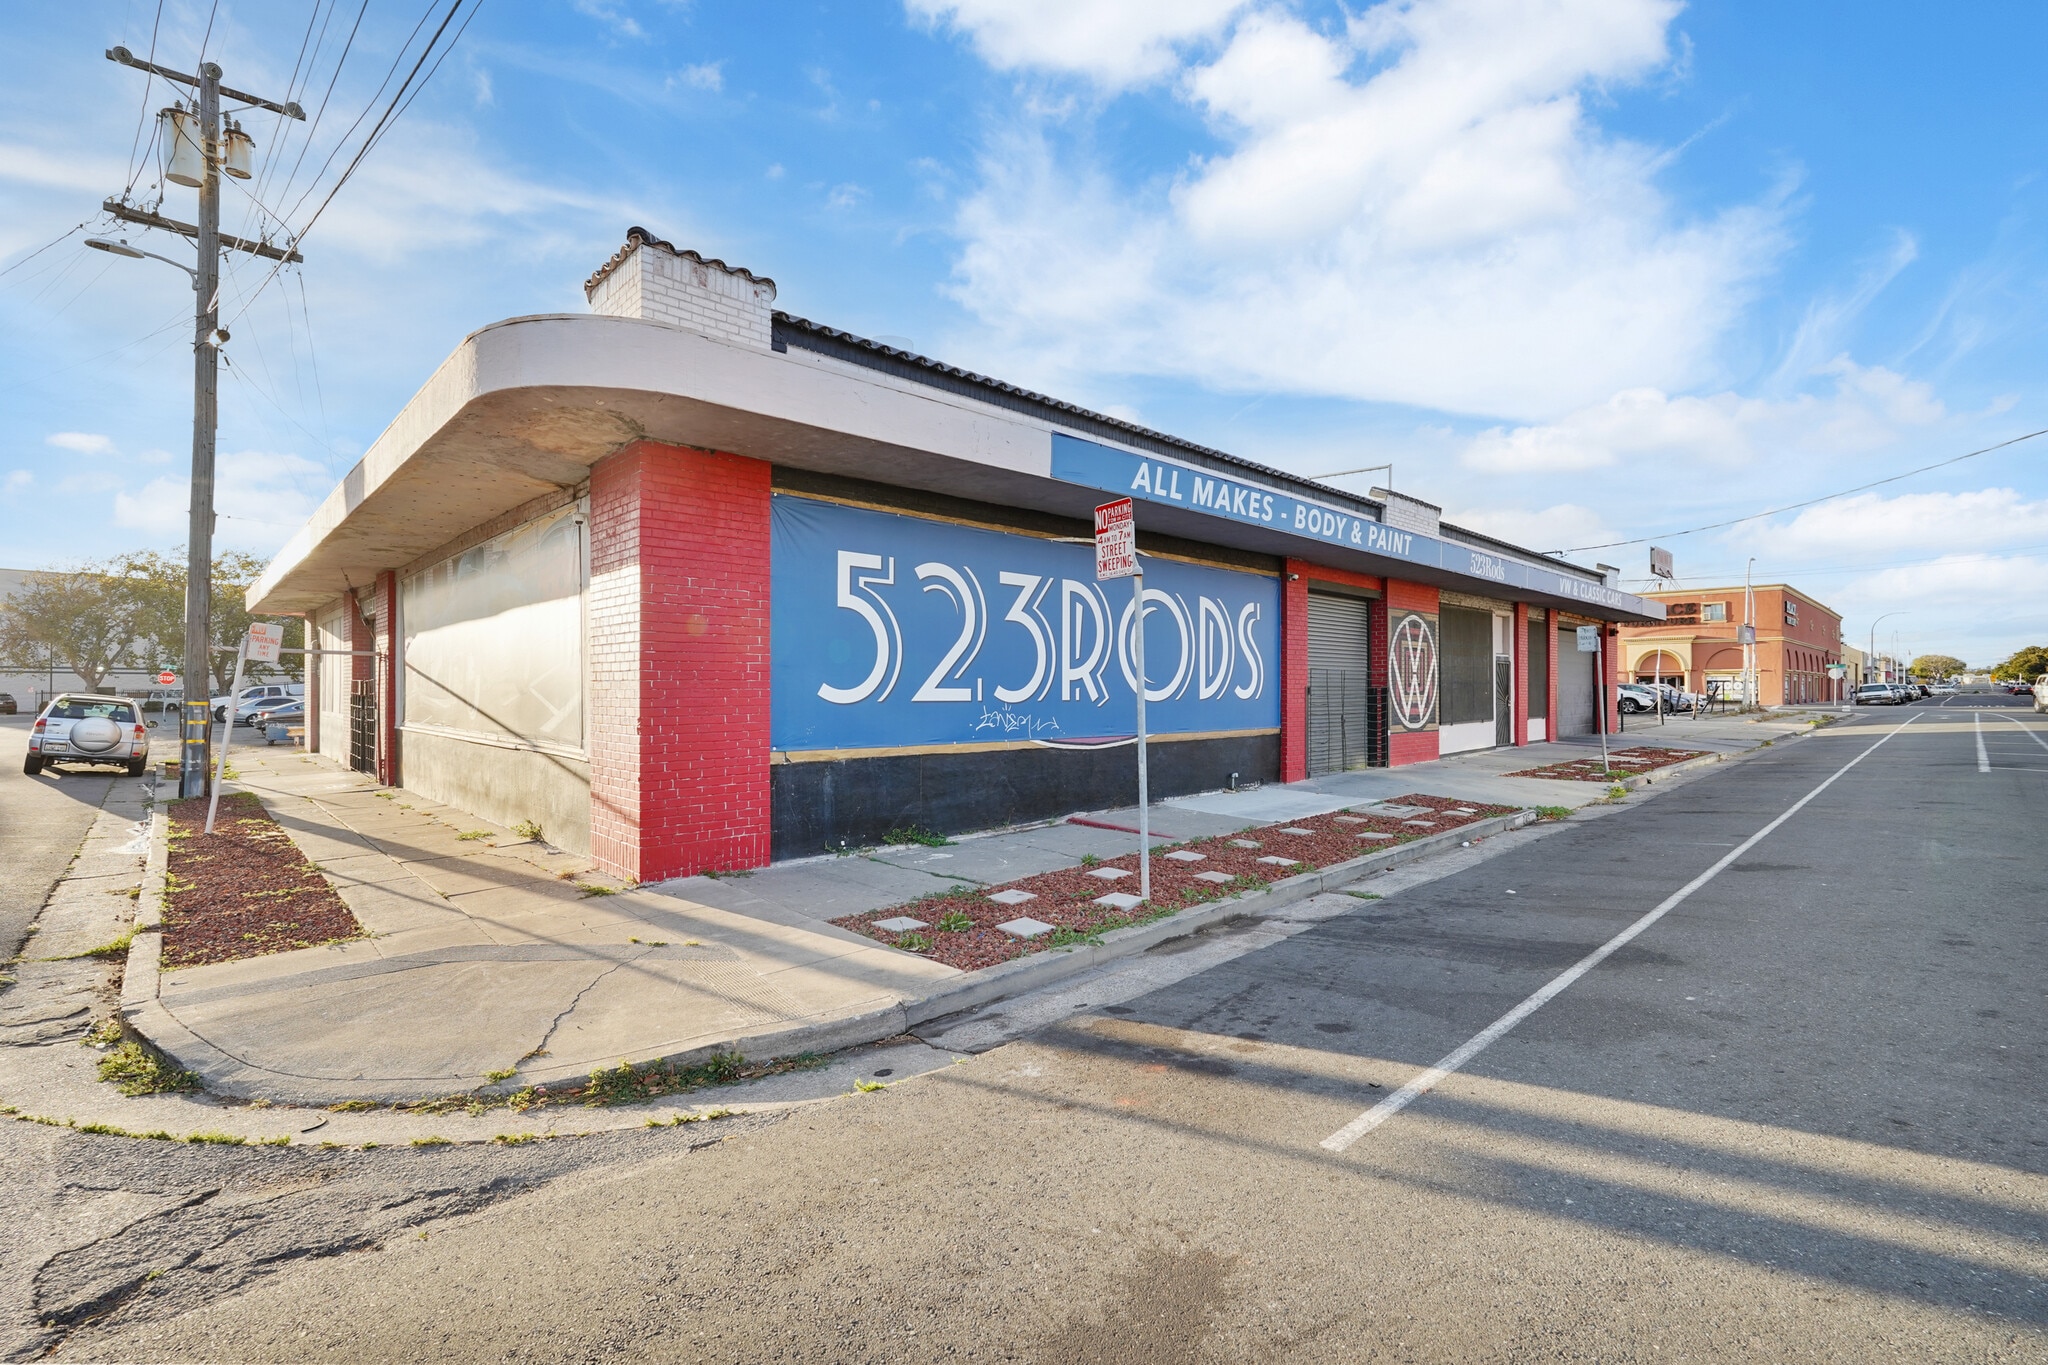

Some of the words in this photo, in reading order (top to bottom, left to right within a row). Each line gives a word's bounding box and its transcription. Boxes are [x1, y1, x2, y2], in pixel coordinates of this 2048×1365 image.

[1095, 508, 1108, 531] NO
[1107, 502, 1131, 518] PARKING
[1130, 462, 1183, 501] ALL
[1192, 476, 1274, 522] MAKES
[1294, 504, 1348, 540] BODY
[1350, 520, 1362, 545] &
[1367, 525, 1413, 556] PAINT
[1108, 521, 1130, 532] MONDAY
[1101, 541, 1127, 559] STREET
[1098, 554, 1132, 573] SWEEPING
[1470, 552, 1505, 581] 523Rods
[1559, 577, 1571, 594] VW
[1573, 582, 1578, 598] &
[1580, 584, 1607, 603] CLASSIC
[1607, 589, 1622, 606] CARS
[251, 635, 279, 646] PARKING
